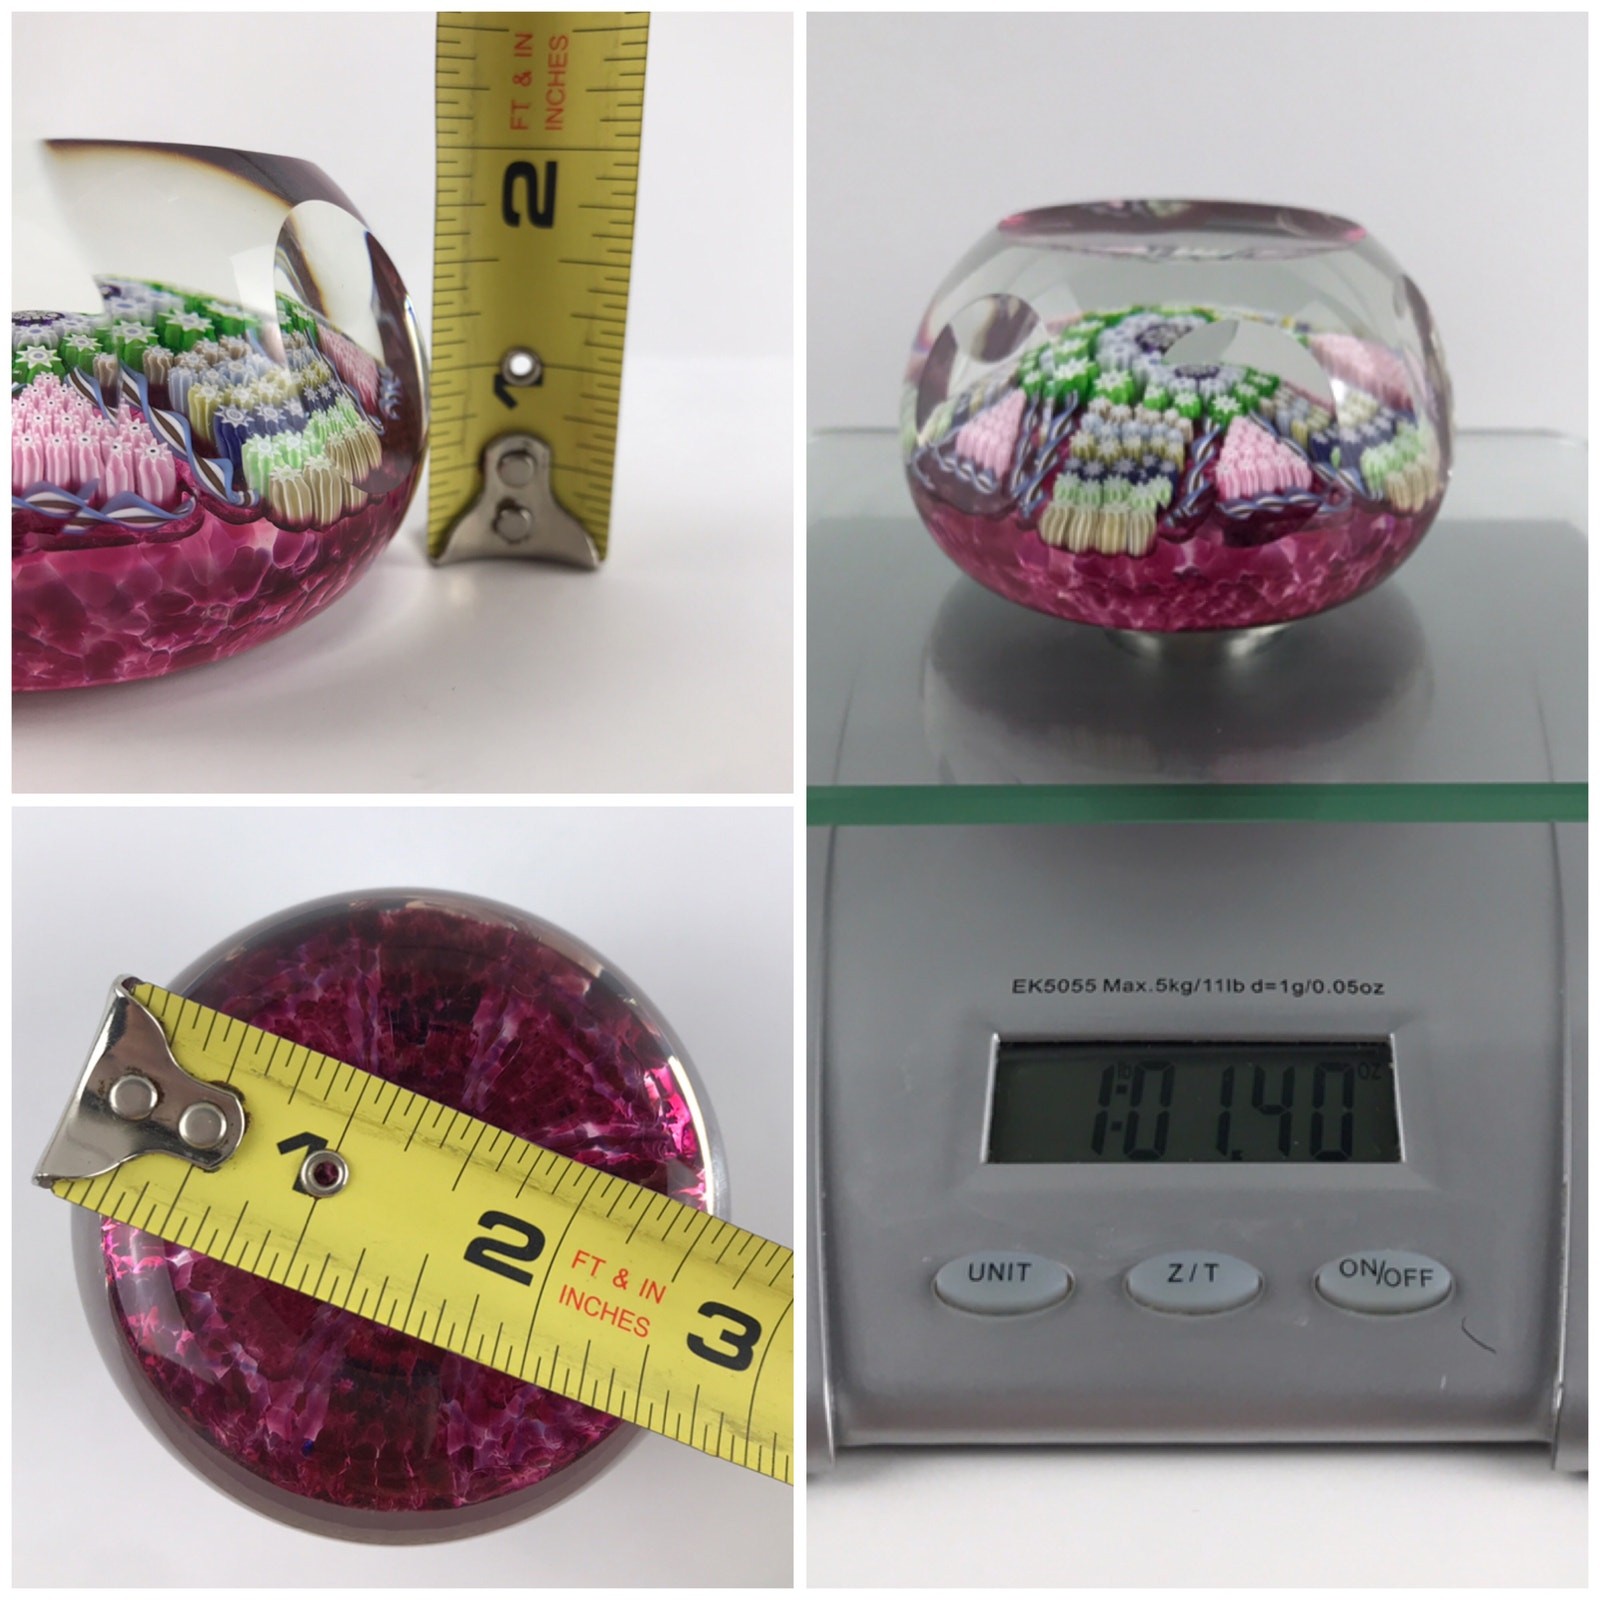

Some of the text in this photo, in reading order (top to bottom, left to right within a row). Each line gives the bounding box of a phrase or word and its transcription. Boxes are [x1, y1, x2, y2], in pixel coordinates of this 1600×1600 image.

[510, 32, 535, 131] FT & IN
[544, 34, 570, 131] INCHES
[501, 160, 558, 229] 2
[1012, 978, 1097, 994] EK5055
[1251, 978, 1385, 997] d=1g/0.05oz
[463, 1209, 546, 1287] 2
[571, 1250, 667, 1304] FT & IN
[968, 1262, 1032, 1283] UNIT
[1339, 1257, 1434, 1289] ON/OFF
[558, 1284, 651, 1338] INCHES
[686, 1301, 763, 1371] 3
